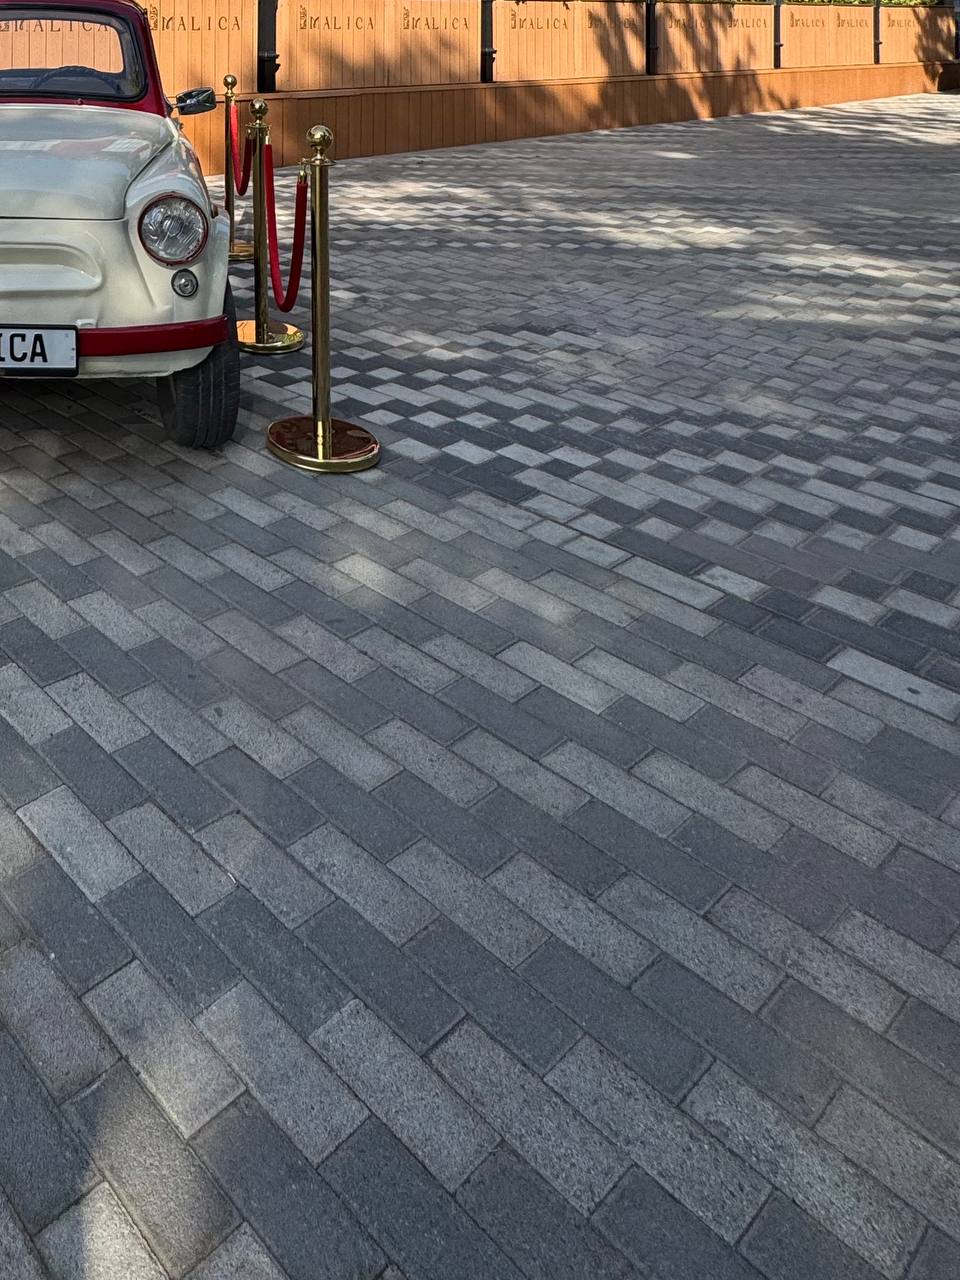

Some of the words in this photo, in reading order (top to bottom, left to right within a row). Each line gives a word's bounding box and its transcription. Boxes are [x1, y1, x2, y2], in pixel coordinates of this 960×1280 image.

[161, 16, 241, 32] MALICA
[309, 16, 375, 30] MALICA
[411, 16, 470, 30] MALICA
[519, 17, 569, 30] MALICA
